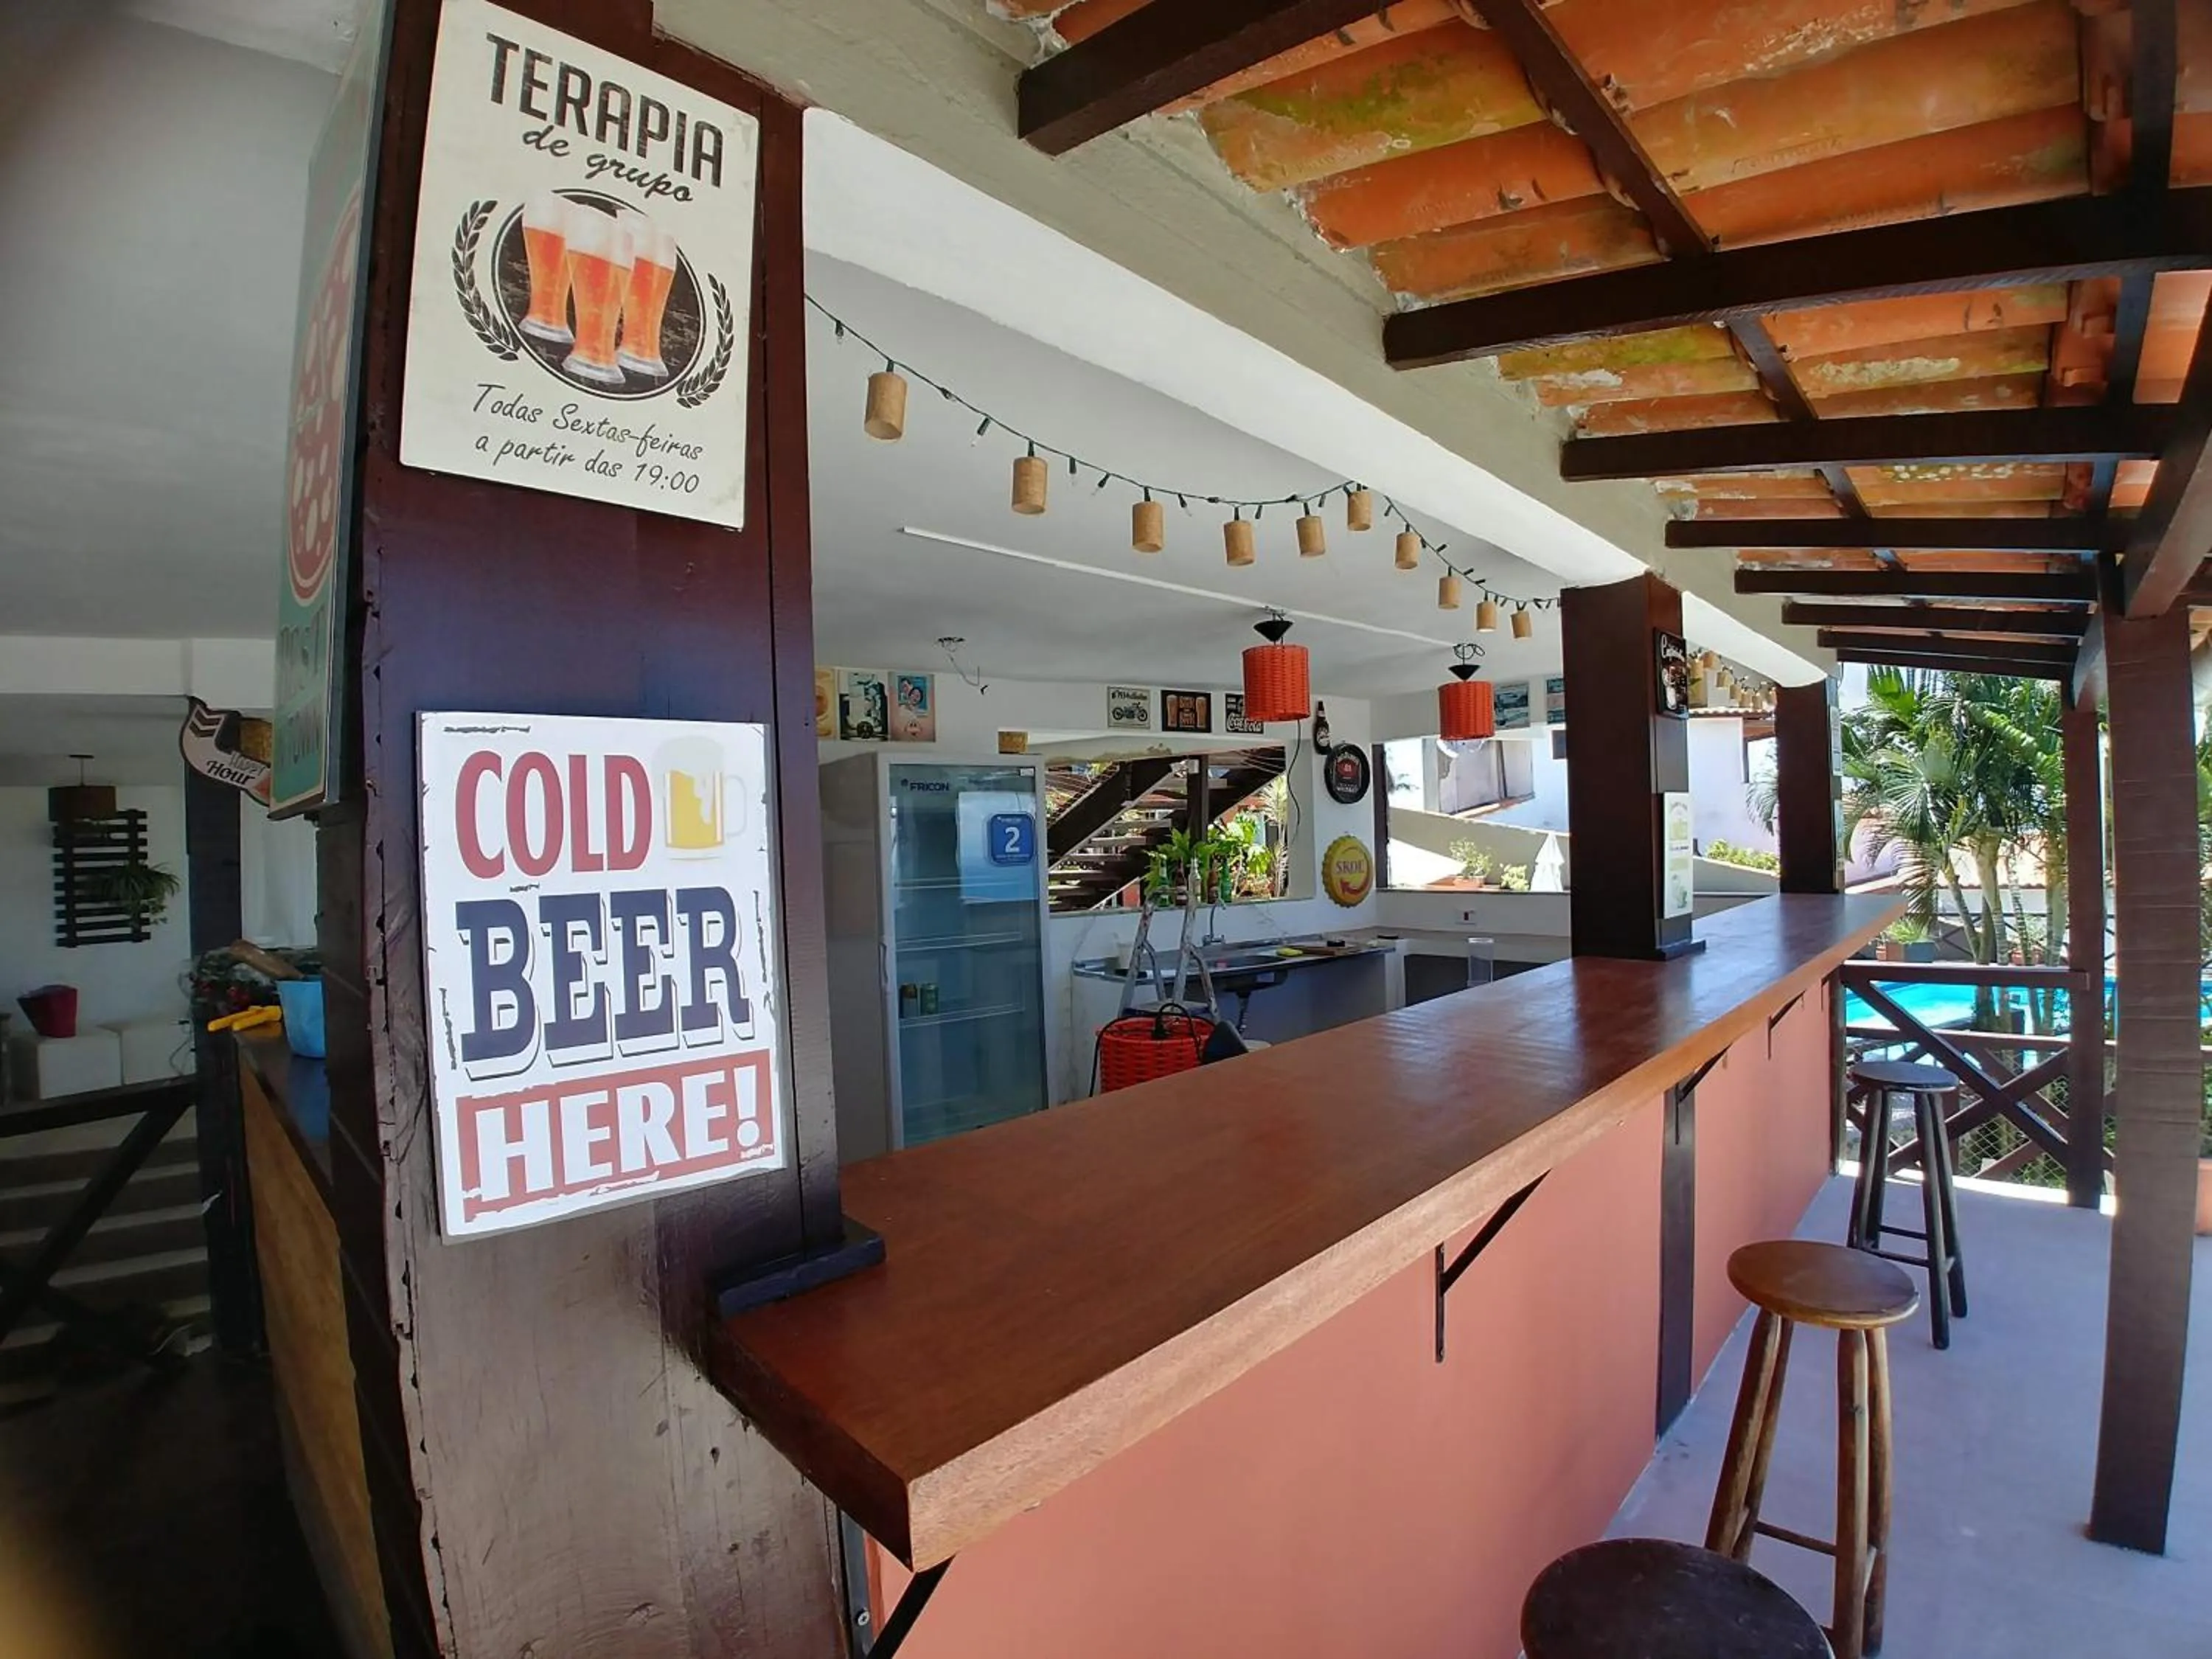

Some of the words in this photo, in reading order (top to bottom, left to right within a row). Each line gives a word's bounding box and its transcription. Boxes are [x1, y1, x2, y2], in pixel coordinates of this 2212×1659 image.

[486, 32, 724, 189] TERAPIA
[523, 125, 571, 157] de
[586, 151, 694, 202] grupo
[472, 383, 543, 423] Todas
[552, 403, 704, 462] Sextas-feiras
[476, 435, 488, 452] a
[493, 442, 576, 467] partir
[585, 450, 624, 479] das
[633, 464, 700, 494] 19:00
[206, 760, 256, 785] Hour
[910, 782, 949, 791] FRICON
[455, 750, 653, 880] COLD
[1004, 826, 1020, 853] 2
[455, 886, 754, 1078] BEER
[474, 1065, 762, 1203] HERE!
